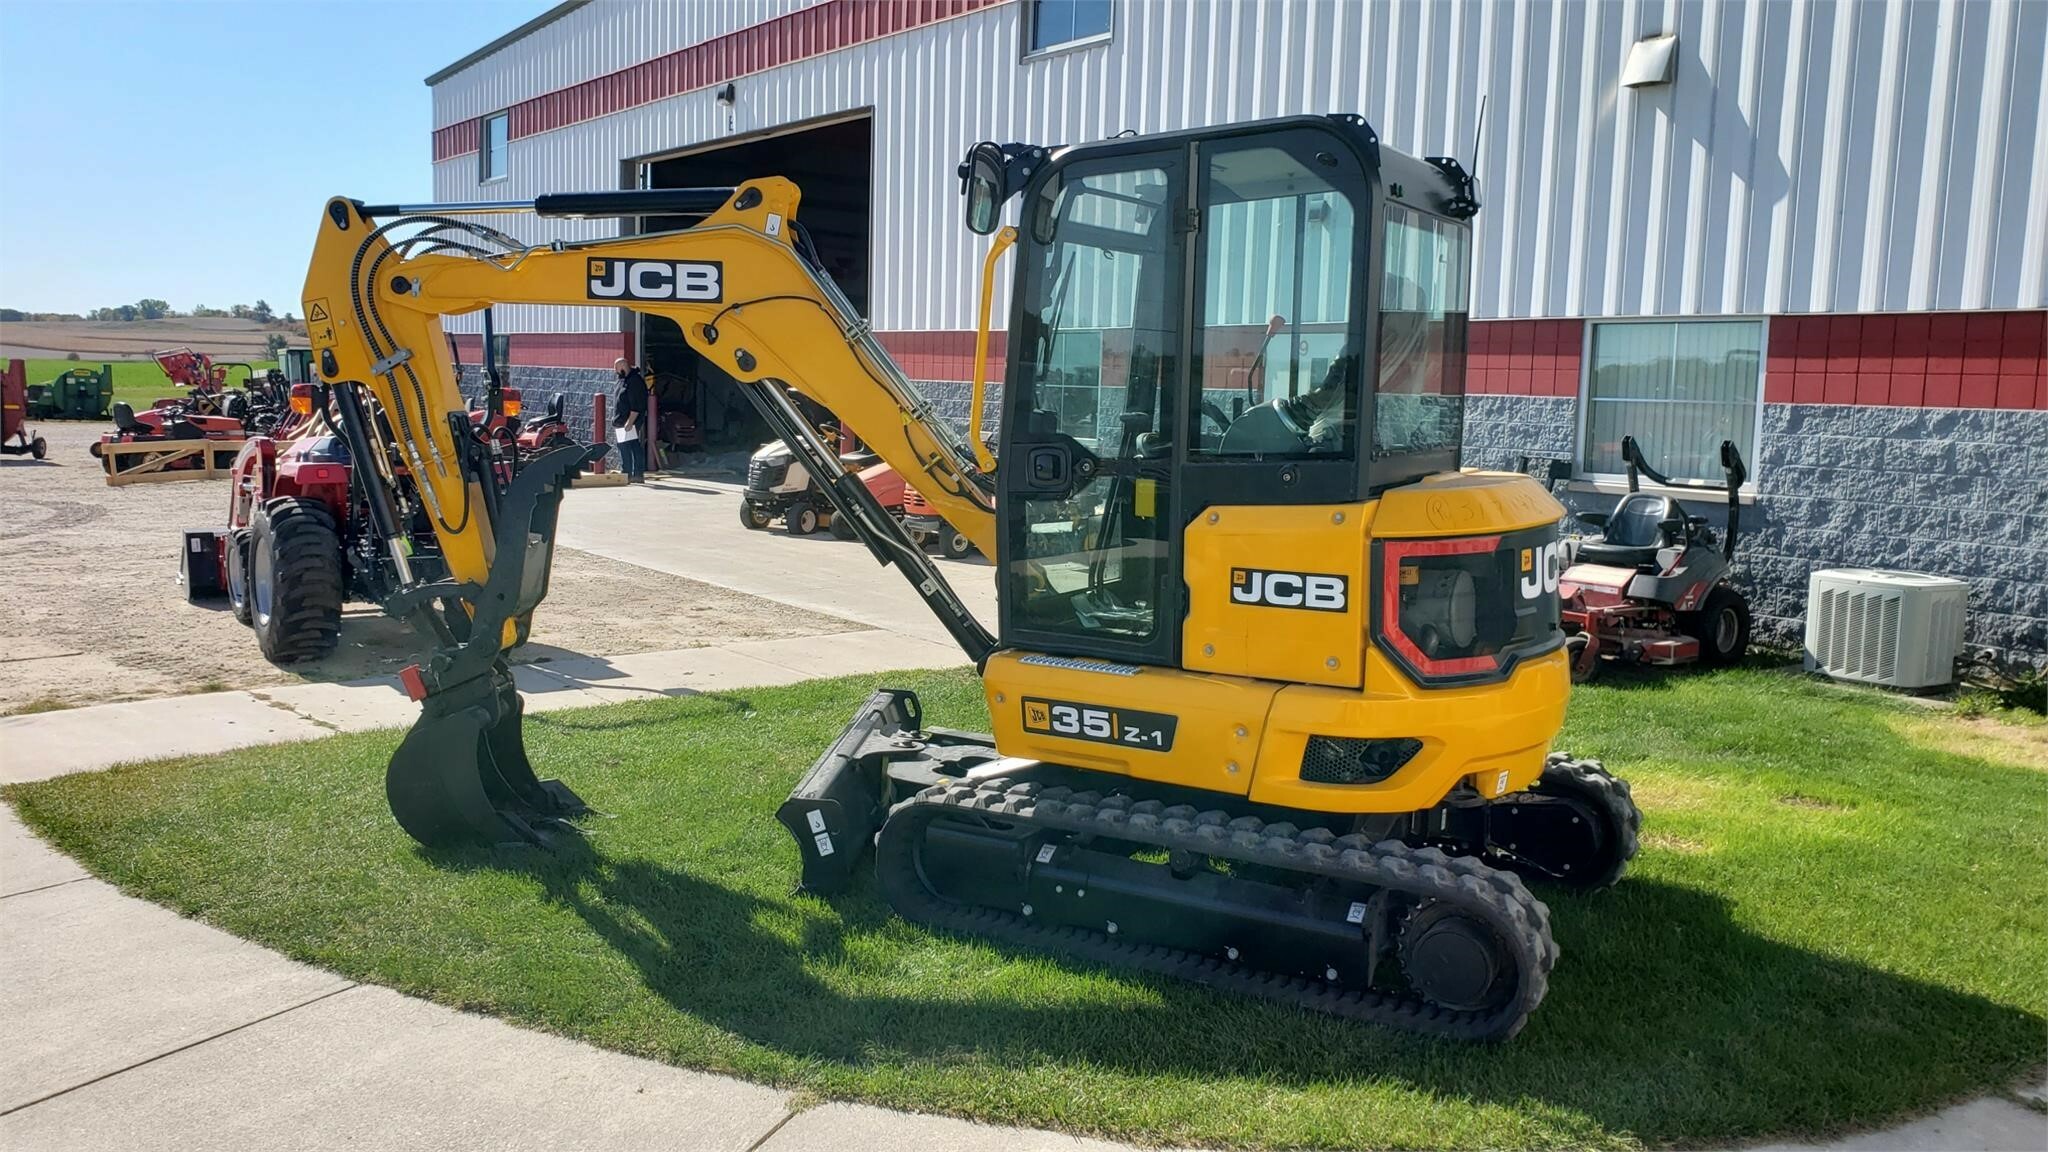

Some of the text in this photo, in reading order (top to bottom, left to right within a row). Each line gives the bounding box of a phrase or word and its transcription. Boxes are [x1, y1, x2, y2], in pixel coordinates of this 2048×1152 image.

[591, 261, 720, 300] JCB
[1233, 571, 1346, 609] JCB
[1521, 541, 1558, 599] JC
[1052, 705, 1163, 746] 35 Z-1
